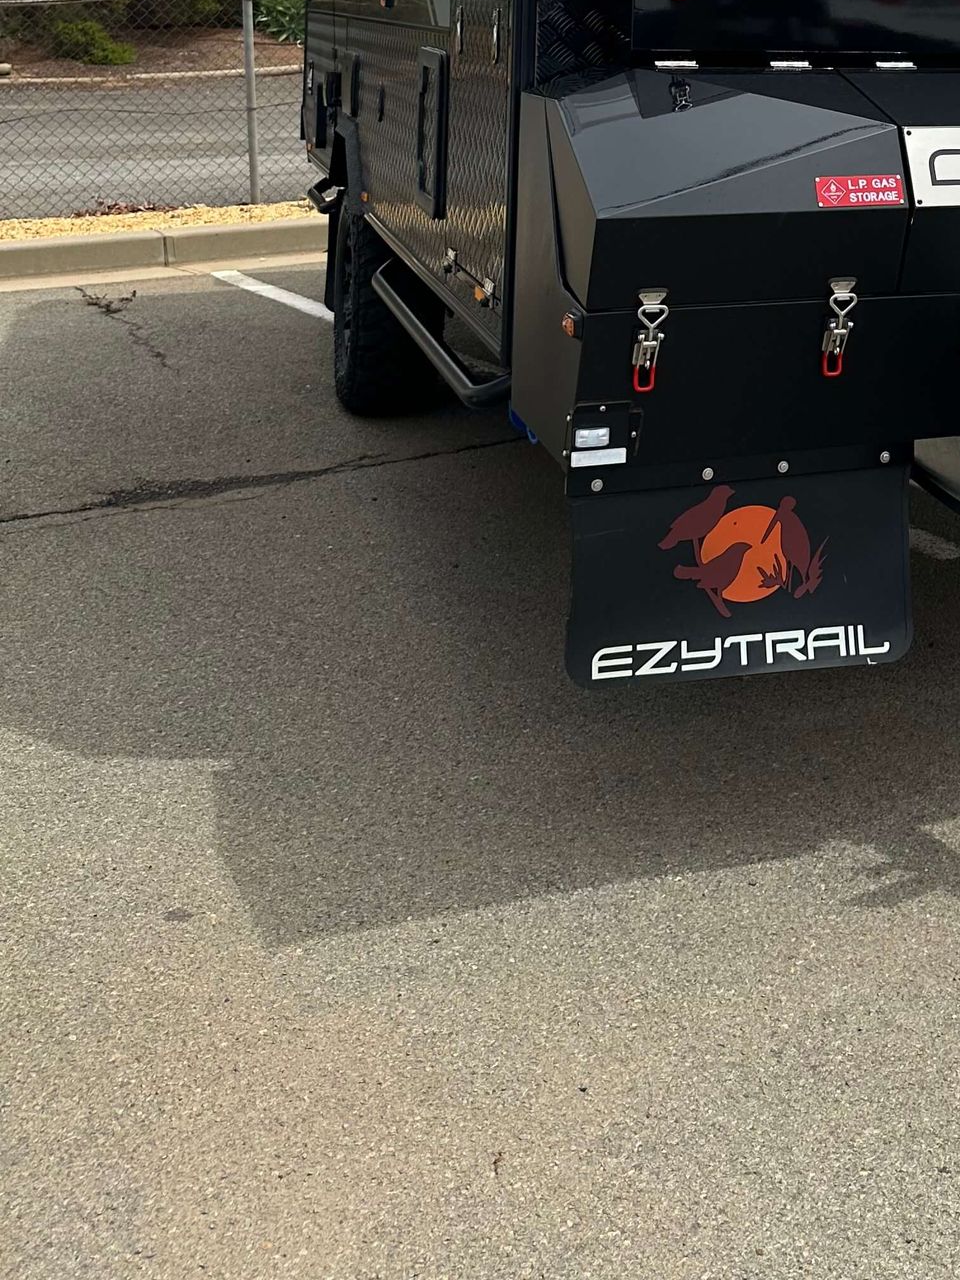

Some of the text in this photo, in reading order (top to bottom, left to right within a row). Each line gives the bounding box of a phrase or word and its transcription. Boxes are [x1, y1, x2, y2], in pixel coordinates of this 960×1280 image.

[847, 178, 897, 190] L.P. GAS
[849, 190, 900, 203] STORAGE
[591, 624, 890, 680] EZYTRAIL
